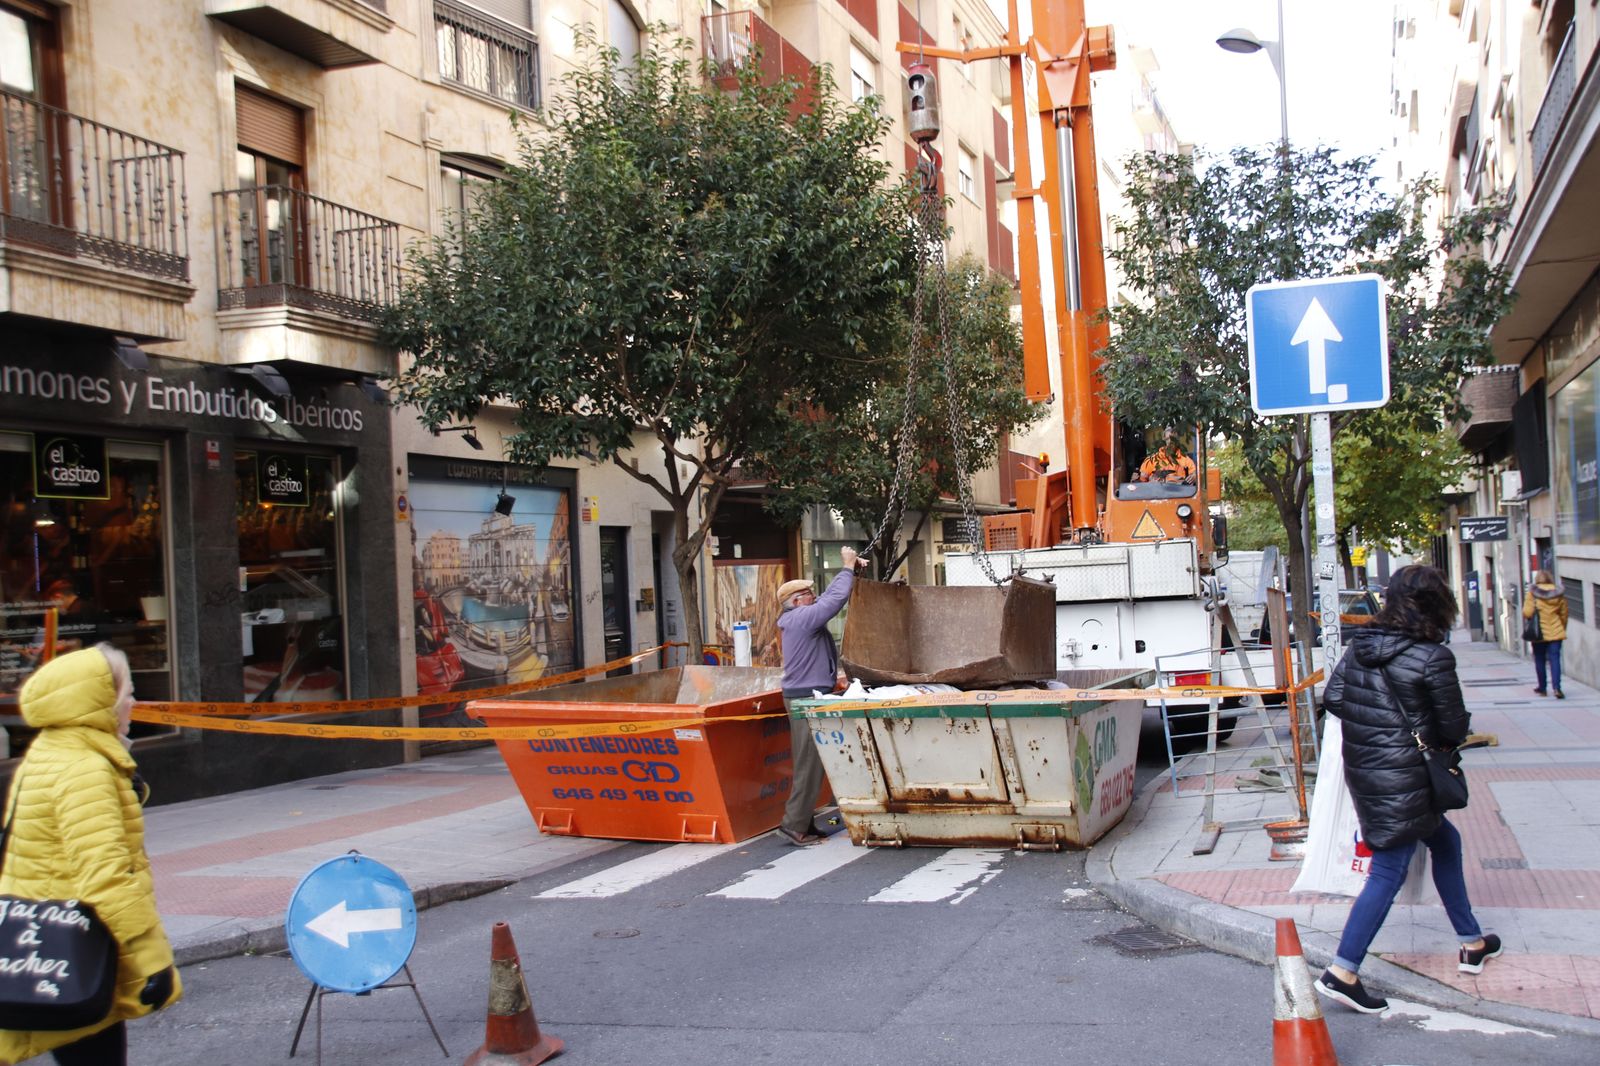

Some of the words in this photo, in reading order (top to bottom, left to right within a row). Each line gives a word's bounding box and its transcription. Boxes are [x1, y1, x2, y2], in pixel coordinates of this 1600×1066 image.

[0, 366, 111, 404] mones
[120, 379, 138, 415] y
[147, 376, 277, 423] Embutidos
[283, 396, 363, 431] Ibéricos
[50, 445, 64, 463] el
[51, 465, 100, 483] castizo
[268, 461, 278, 477] el
[268, 478, 303, 492] castizo
[527, 736, 680, 755] CONTENEDORES
[546, 765, 618, 775] GRUAS
[552, 787, 594, 800] 646
[598, 787, 629, 800] 49
[631, 789, 661, 802] 18
[663, 790, 695, 803] 00
[17, 922, 43, 945] à
